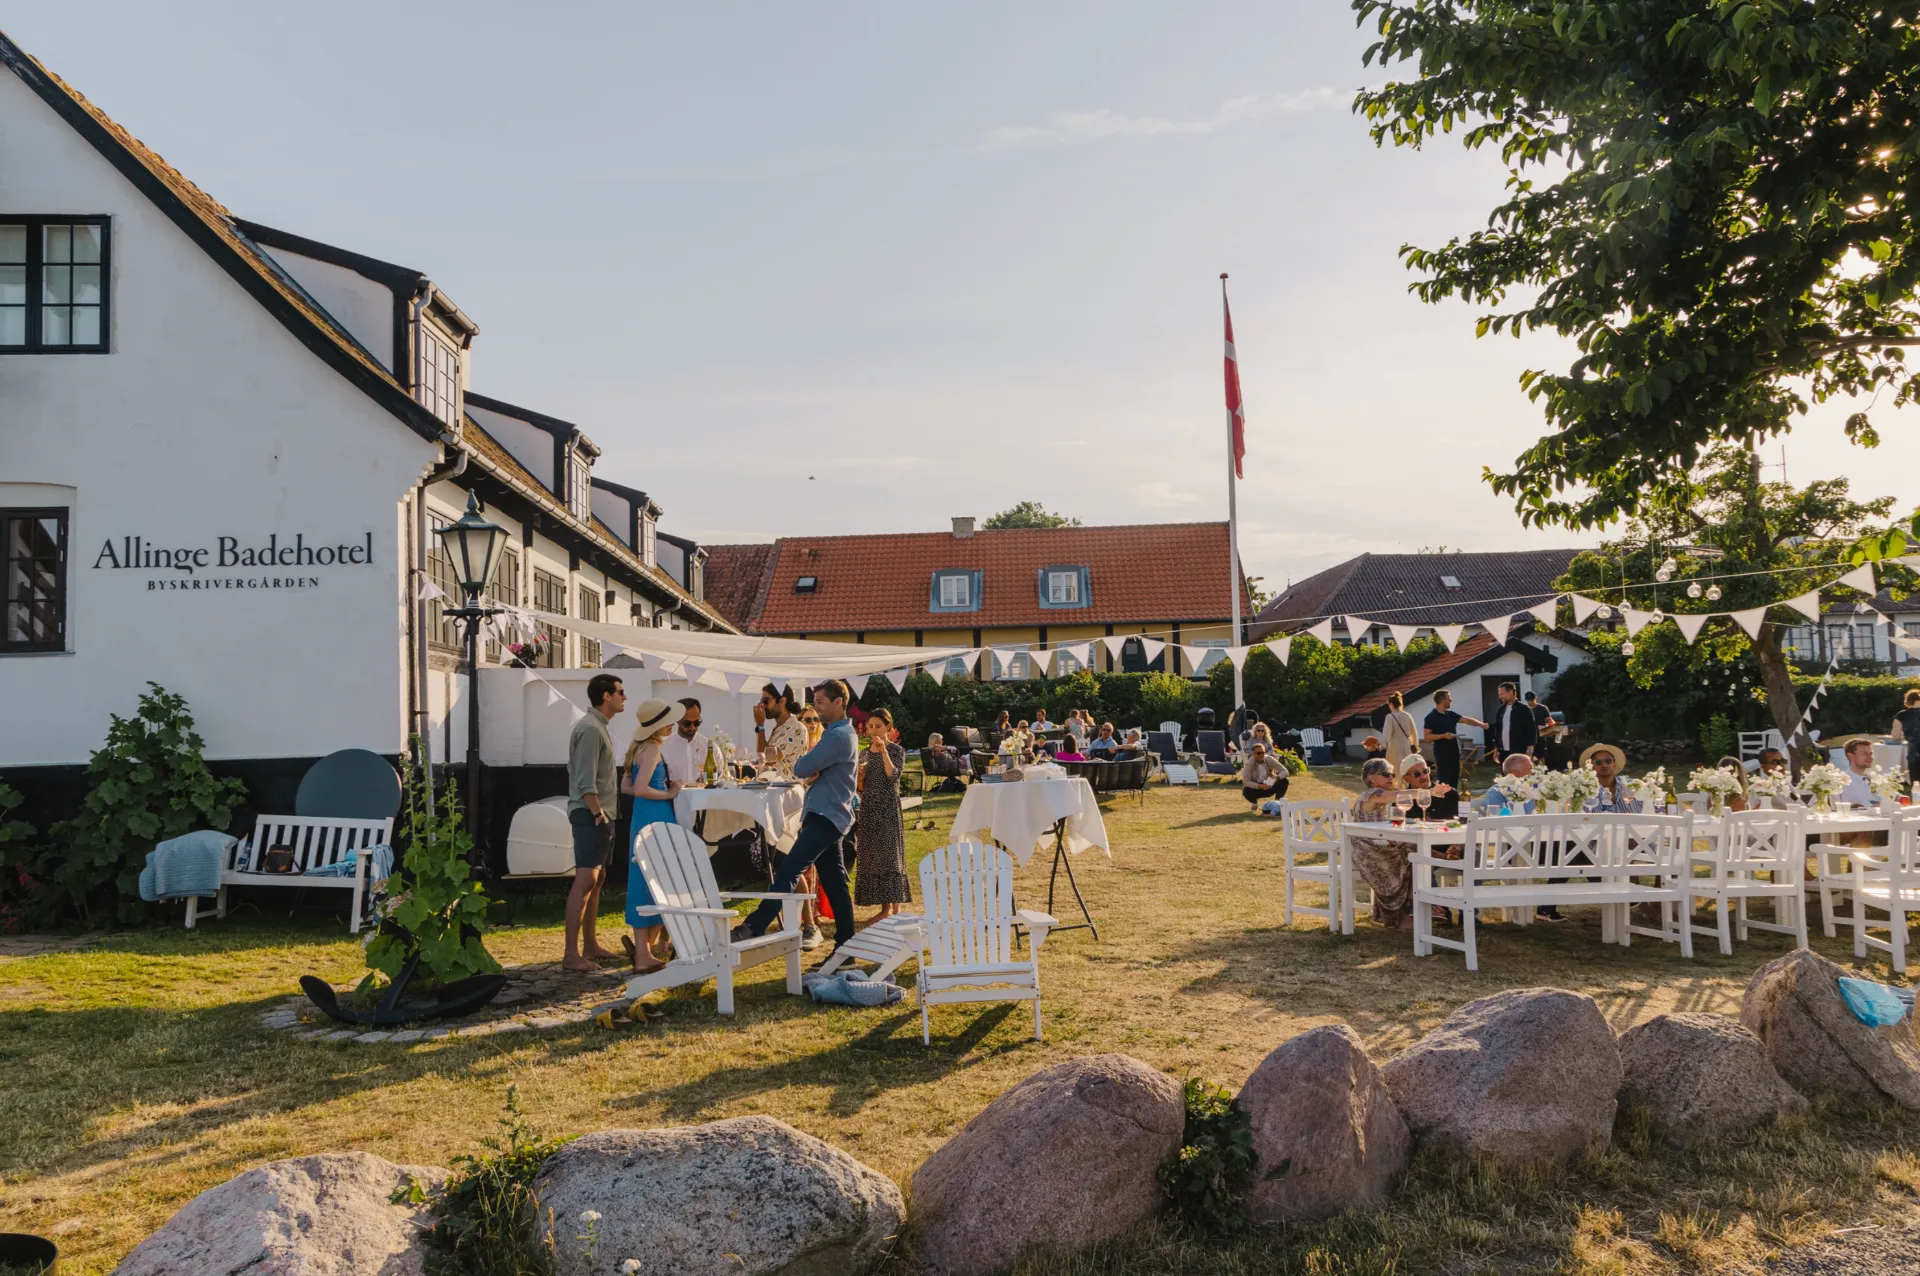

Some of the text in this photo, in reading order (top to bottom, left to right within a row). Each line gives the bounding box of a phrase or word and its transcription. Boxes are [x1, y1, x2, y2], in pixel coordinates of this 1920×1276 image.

[92, 531, 375, 575] Allinge Badehotel
[147, 576, 320, 591] BYSKRIVERGÅRDEN
